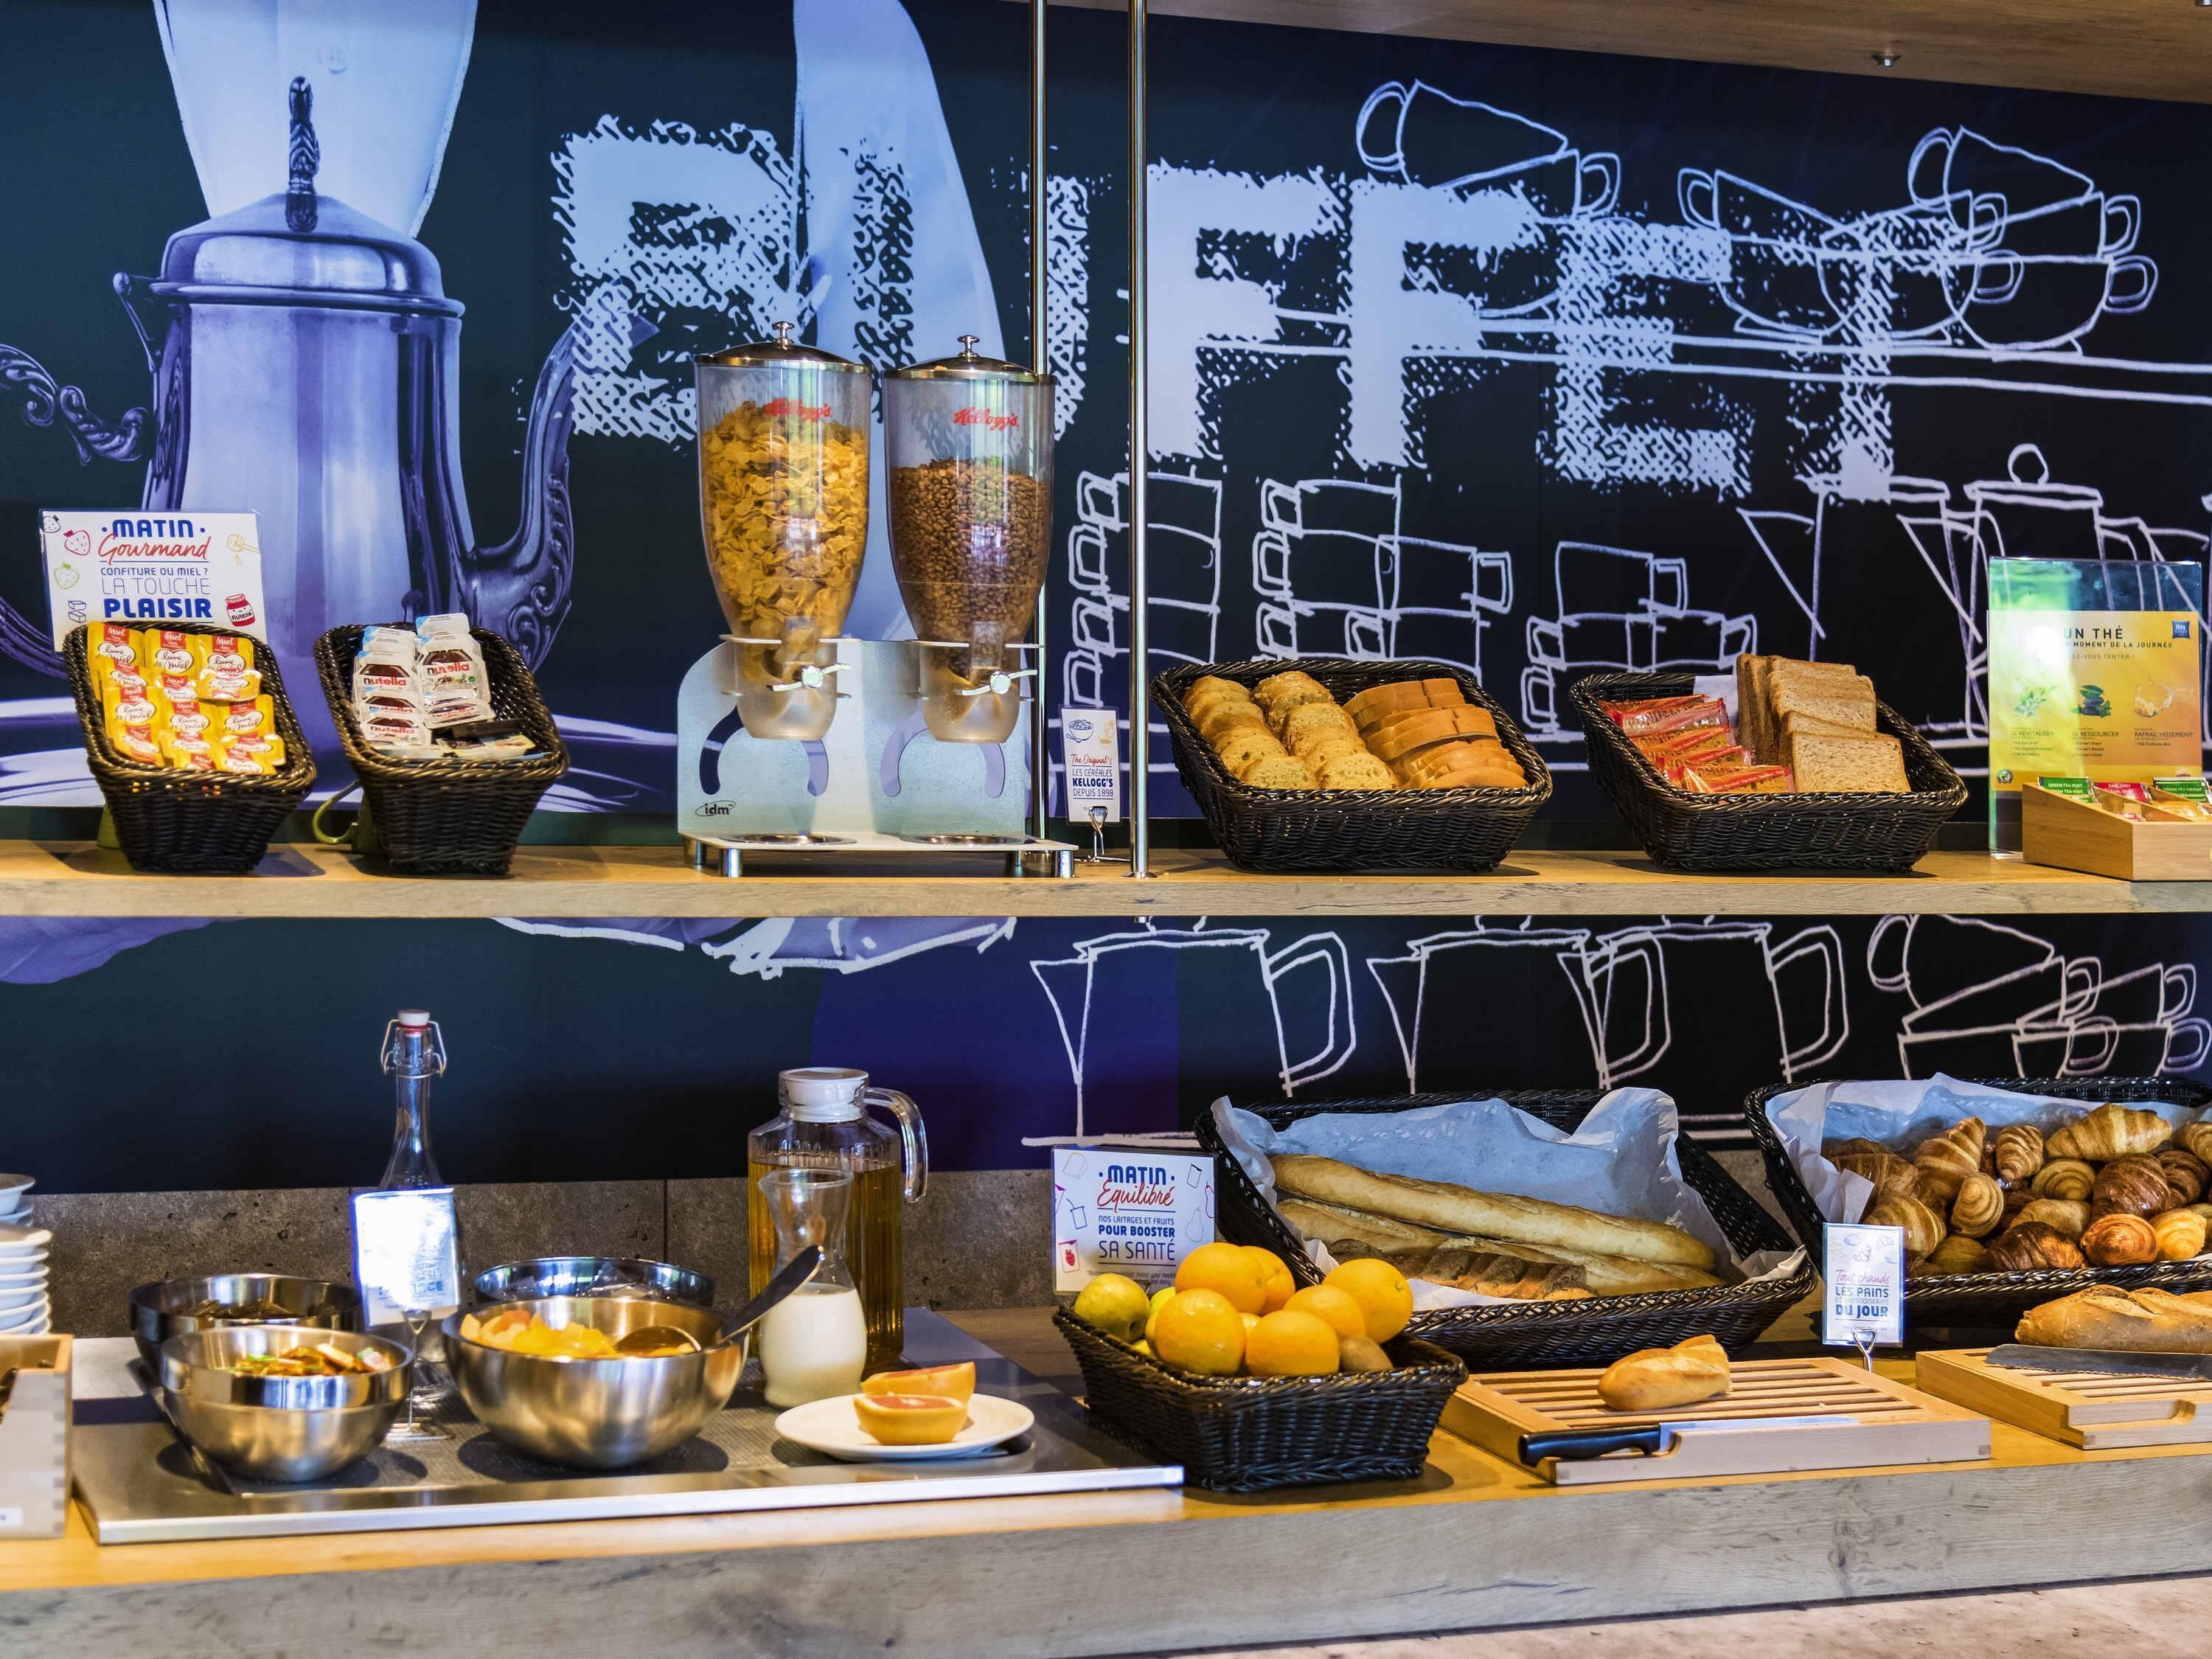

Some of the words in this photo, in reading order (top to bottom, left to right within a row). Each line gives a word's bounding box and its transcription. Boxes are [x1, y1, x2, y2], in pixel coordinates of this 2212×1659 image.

[953, 407, 1020, 432] Kellogg's
[112, 518, 194, 538] MATIN
[98, 532, 212, 566] Gourmand
[100, 567, 156, 576] CONFITURE
[159, 567, 175, 576] OU
[177, 567, 201, 576] MIEL
[203, 567, 209, 576] ?
[102, 577, 125, 595] LA
[131, 577, 211, 595] TOUCHE
[104, 597, 213, 619] PLAISIR
[232, 611, 252, 621] nutella
[107, 627, 125, 636] Miel
[164, 630, 182, 641] Miel
[2093, 625, 2124, 639] THÉ
[216, 636, 234, 645] Miel
[364, 676, 407, 686] nutella
[370, 726, 414, 734] nutella
[1071, 753, 1083, 764] The
[1072, 768, 1083, 776] LES
[1084, 767, 1113, 777] CÉRÉALES
[1073, 778, 1113, 787] KELLOGG'S
[1073, 788, 1096, 797] DEPUIS
[1098, 788, 1114, 797] 1898
[704, 803, 730, 815] idm
[1107, 1164, 1167, 1186] MATIN
[1098, 1215, 1112, 1223] NOS
[1113, 1216, 1143, 1224] LAITAGES
[1153, 1217, 1175, 1225] FRUITS
[1099, 1224, 1127, 1236] POUR
[1130, 1225, 1175, 1238] BOOSTER
[1099, 1240, 1119, 1259] SA
[1125, 1238, 1175, 1261] SANTÉ
[1834, 1268, 1857, 1283] Tout
[1858, 1270, 1889, 1284] chauds
[1835, 1285, 1853, 1297] LES
[1857, 1287, 1889, 1298] PAINS
[1835, 1304, 1853, 1316] DU
[1857, 1304, 1888, 1318] JOUR
